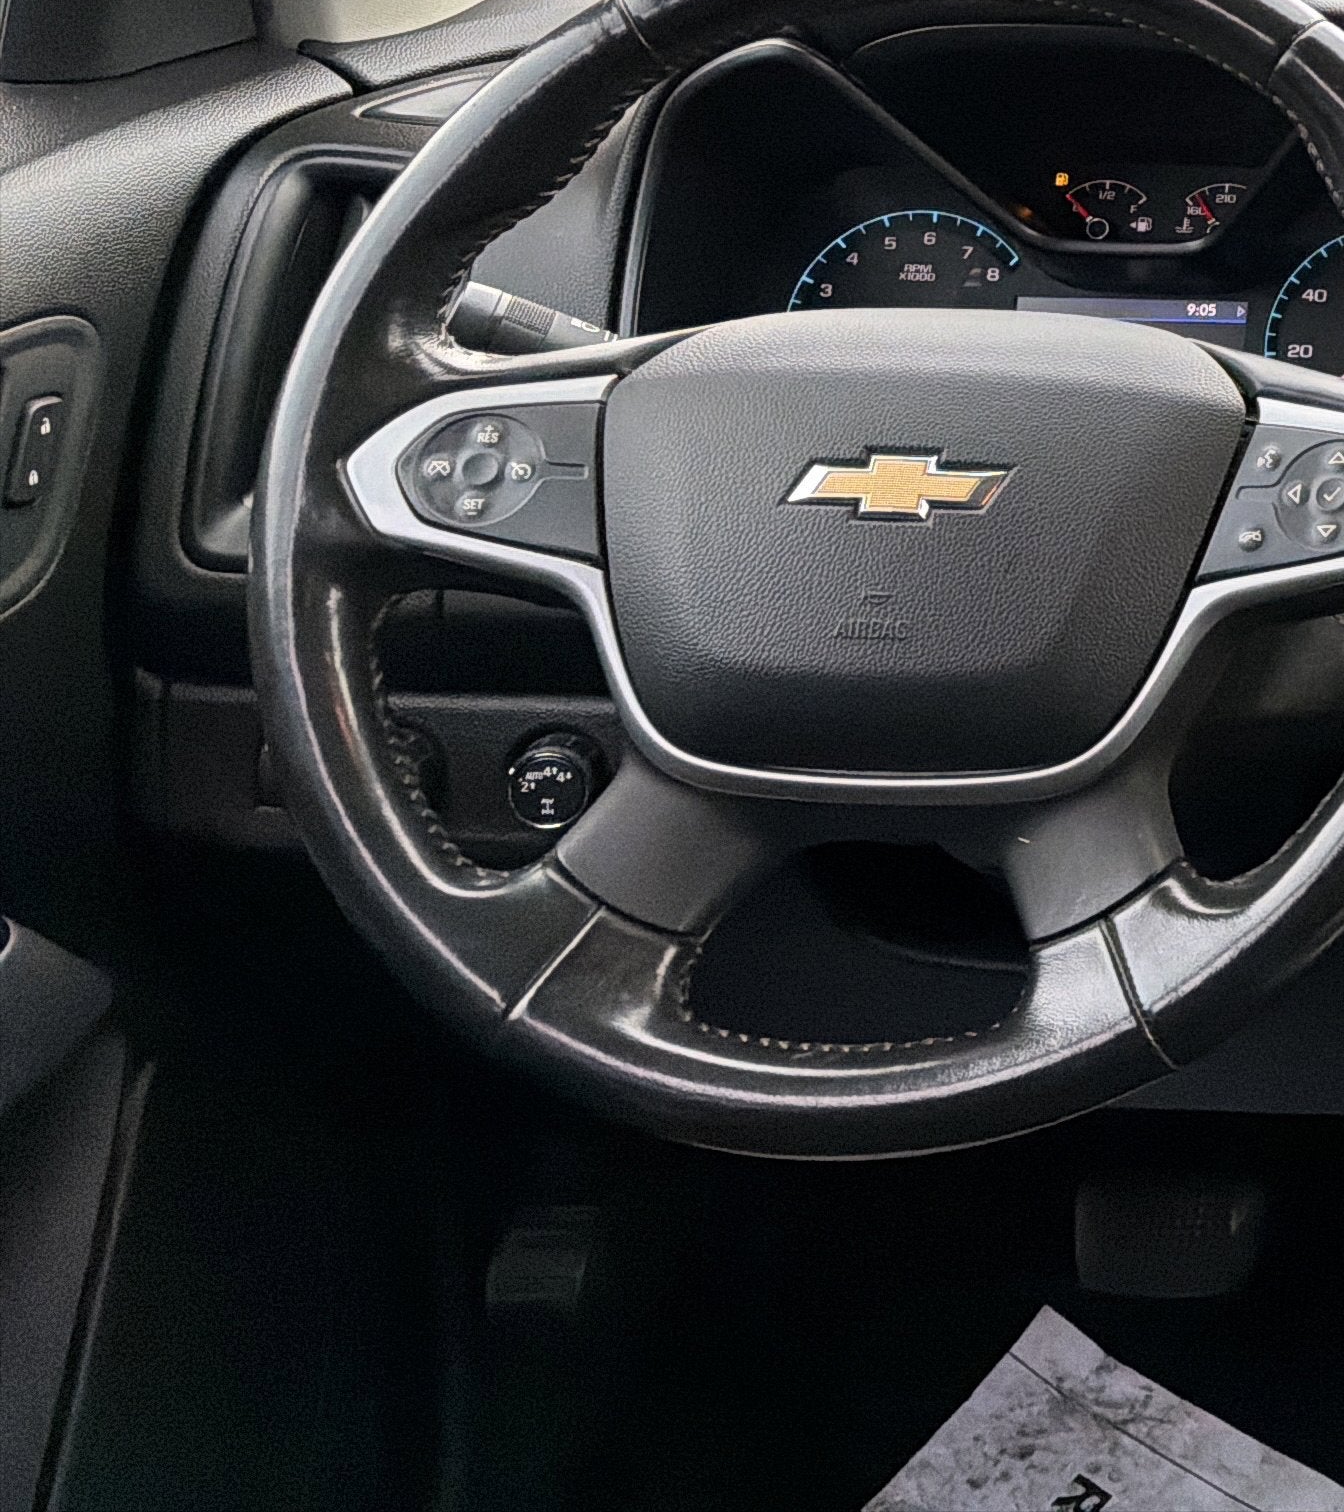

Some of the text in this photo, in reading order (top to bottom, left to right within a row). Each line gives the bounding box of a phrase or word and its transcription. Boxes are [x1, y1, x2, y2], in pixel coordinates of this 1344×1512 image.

[1098, 190, 1117, 201] 1/2
[1215, 194, 1237, 204] 210
[1130, 205, 1138, 214] F
[883, 236, 898, 251] 5
[923, 231, 937, 246] 6
[845, 252, 860, 266] 4
[960, 245, 974, 260] 7
[903, 263, 933, 273] RPM
[986, 267, 1000, 282] 8
[819, 283, 833, 298] 3
[1301, 288, 1328, 303] 40
[1186, 302, 1217, 317] 9:05
[1287, 344, 1313, 358] 20
[476, 432, 500, 444] RES
[463, 498, 485, 510] SET
[832, 618, 908, 640] AIRBAG
